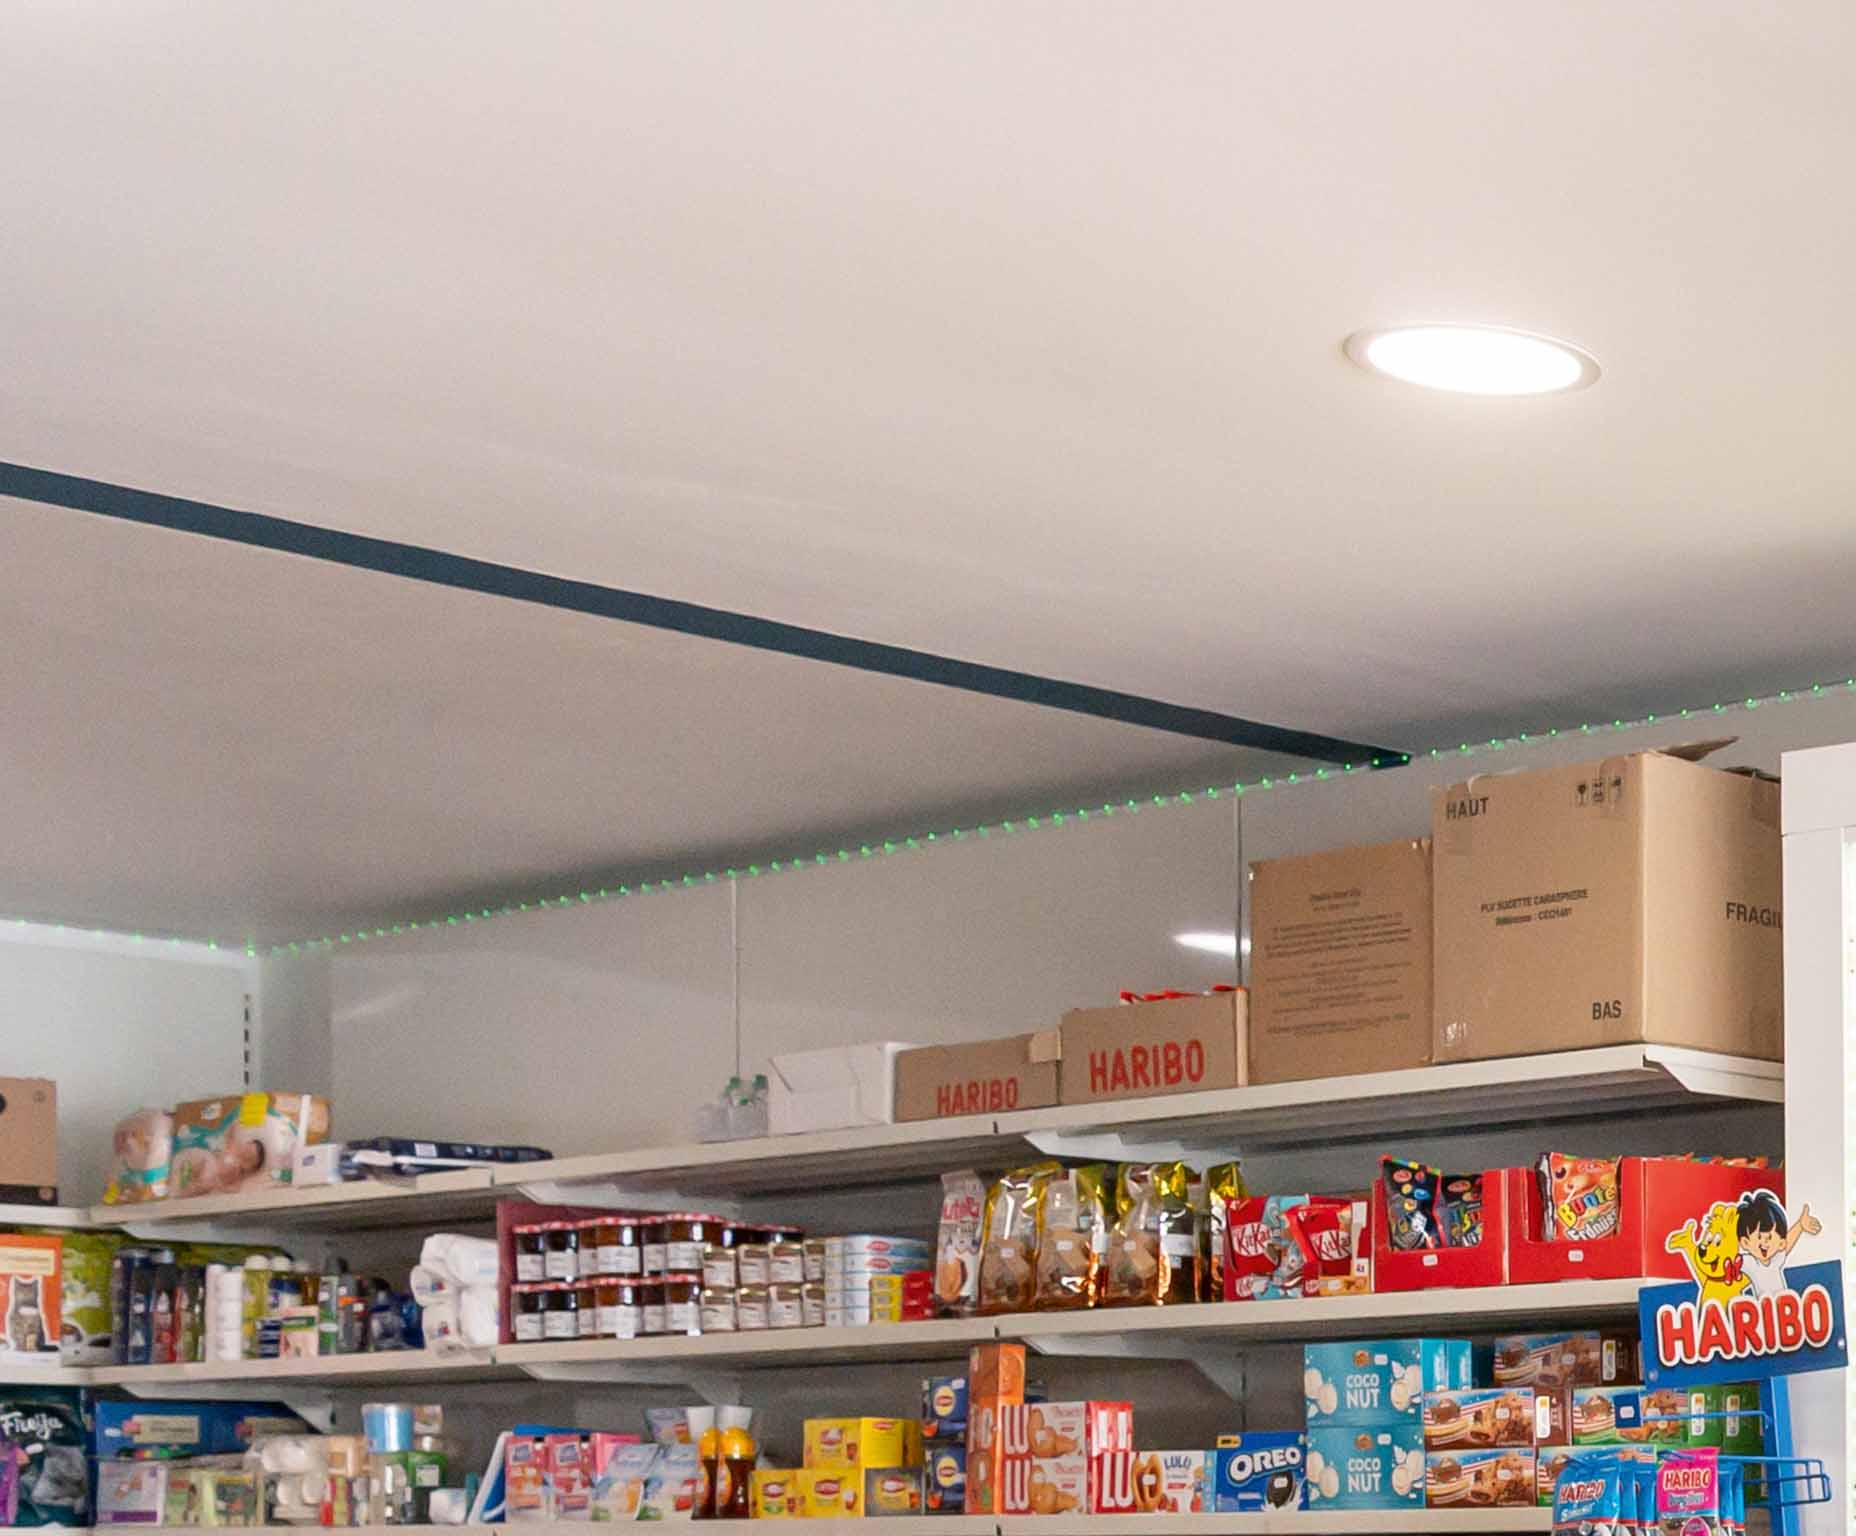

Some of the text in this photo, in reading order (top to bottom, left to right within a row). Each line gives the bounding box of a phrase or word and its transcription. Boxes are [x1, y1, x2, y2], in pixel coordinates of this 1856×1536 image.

[1446, 797, 1489, 820] HAUT
[1592, 1000, 1622, 1020] BAS
[1089, 1039, 1205, 1095] HARIBO
[936, 1077, 1018, 1115] HARIBO
[1660, 1285, 1832, 1367] HARIBO
[1347, 1373, 1379, 1391] COCO
[1347, 1390, 1379, 1408] NUT
[1003, 1405, 1029, 1455] LU
[1230, 1448, 1302, 1481] OREO
[1348, 1457, 1380, 1474] COCO
[1004, 1459, 1031, 1511] LU
[1101, 1452, 1135, 1508] LU
[1348, 1473, 1380, 1493] NUT
[1664, 1469, 1711, 1491] HARIBO
